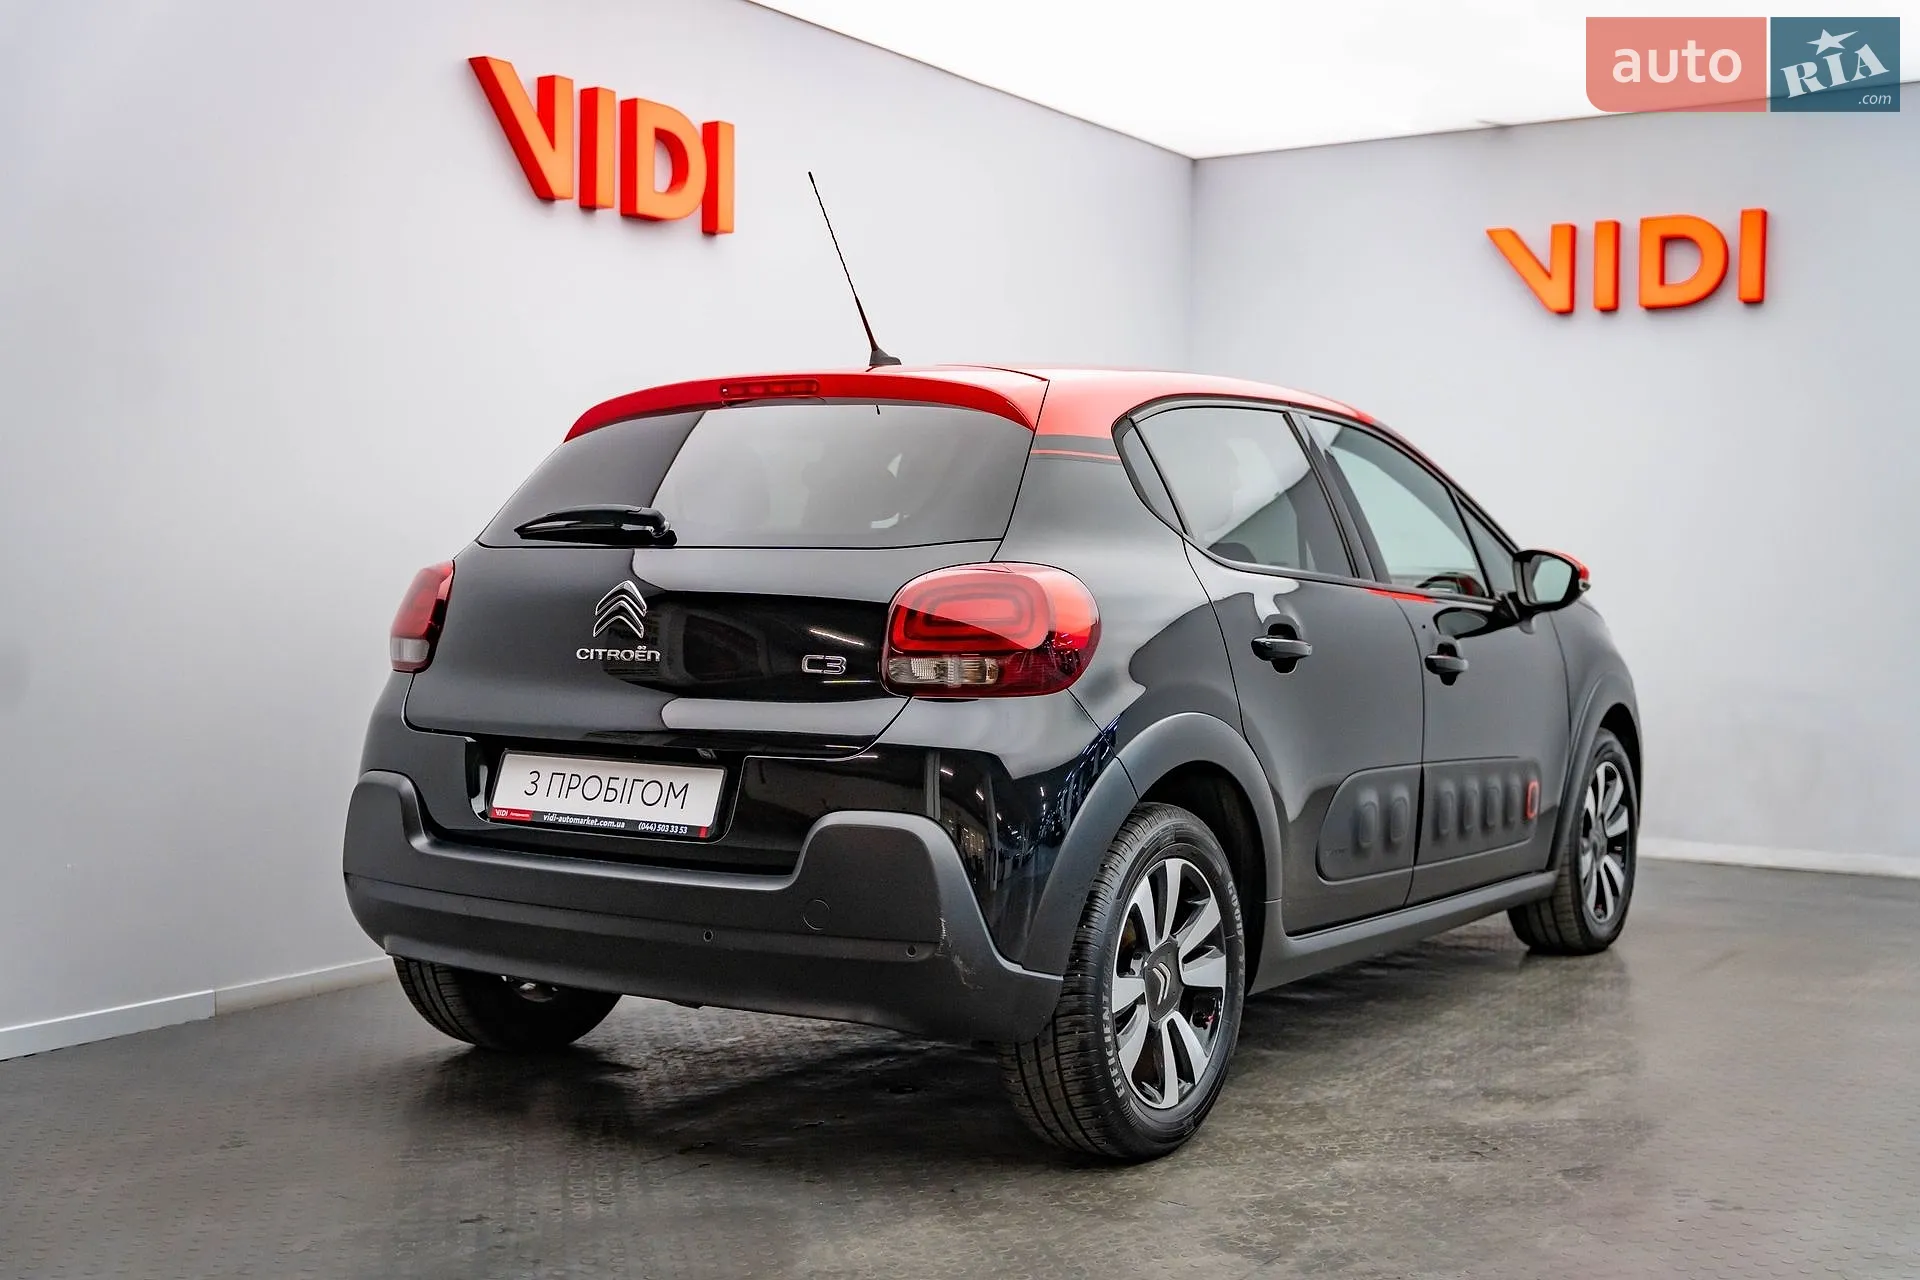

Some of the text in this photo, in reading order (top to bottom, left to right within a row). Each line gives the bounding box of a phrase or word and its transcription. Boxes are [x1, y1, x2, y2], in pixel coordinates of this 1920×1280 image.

[468, 56, 734, 235] VIDI
[1486, 208, 1767, 314] VIDI
[802, 654, 847, 675] C3
[547, 772, 689, 809] ПРОБІГОМ
[495, 809, 508, 817] VIDI
[543, 813, 688, 834] vidi-automarket.com.ua (044) 503 33 53
